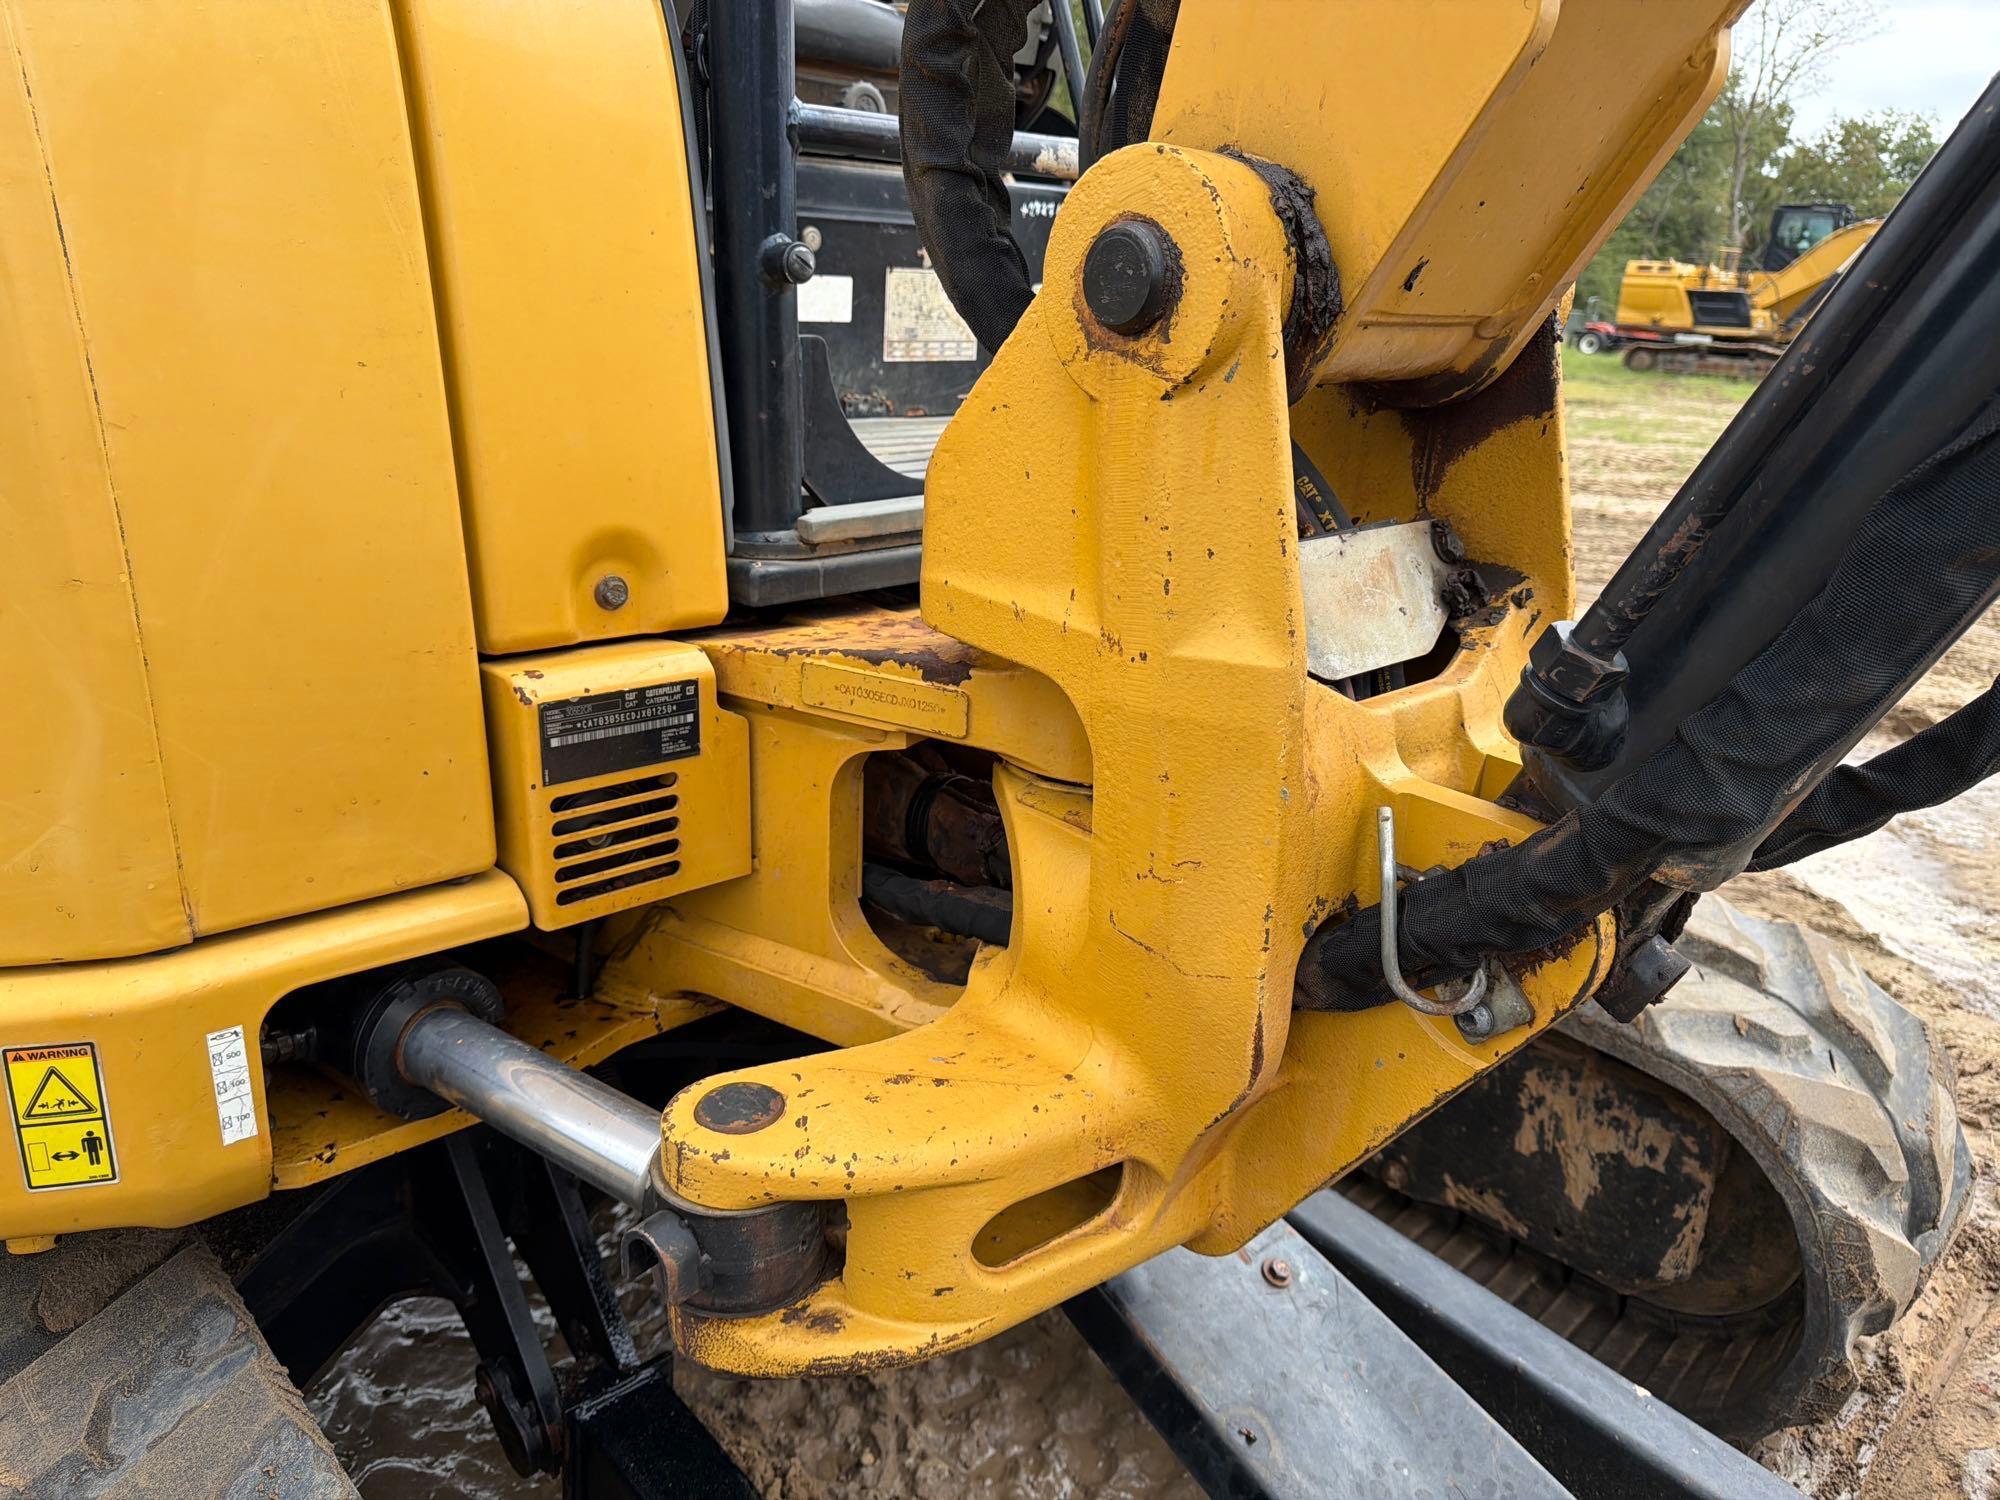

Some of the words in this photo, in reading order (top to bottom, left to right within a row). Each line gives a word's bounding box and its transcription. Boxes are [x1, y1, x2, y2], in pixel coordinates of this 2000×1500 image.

[1296, 476, 1319, 499] CAT
[1318, 510, 1338, 531] XT
[625, 691, 638, 701] CAT
[645, 685, 682, 698] CATERPILLAR
[625, 700, 639, 709] CAT
[645, 693, 683, 705] CATERPILLAR
[26, 1048, 89, 1062] WARNING
[226, 1050, 241, 1060] 500
